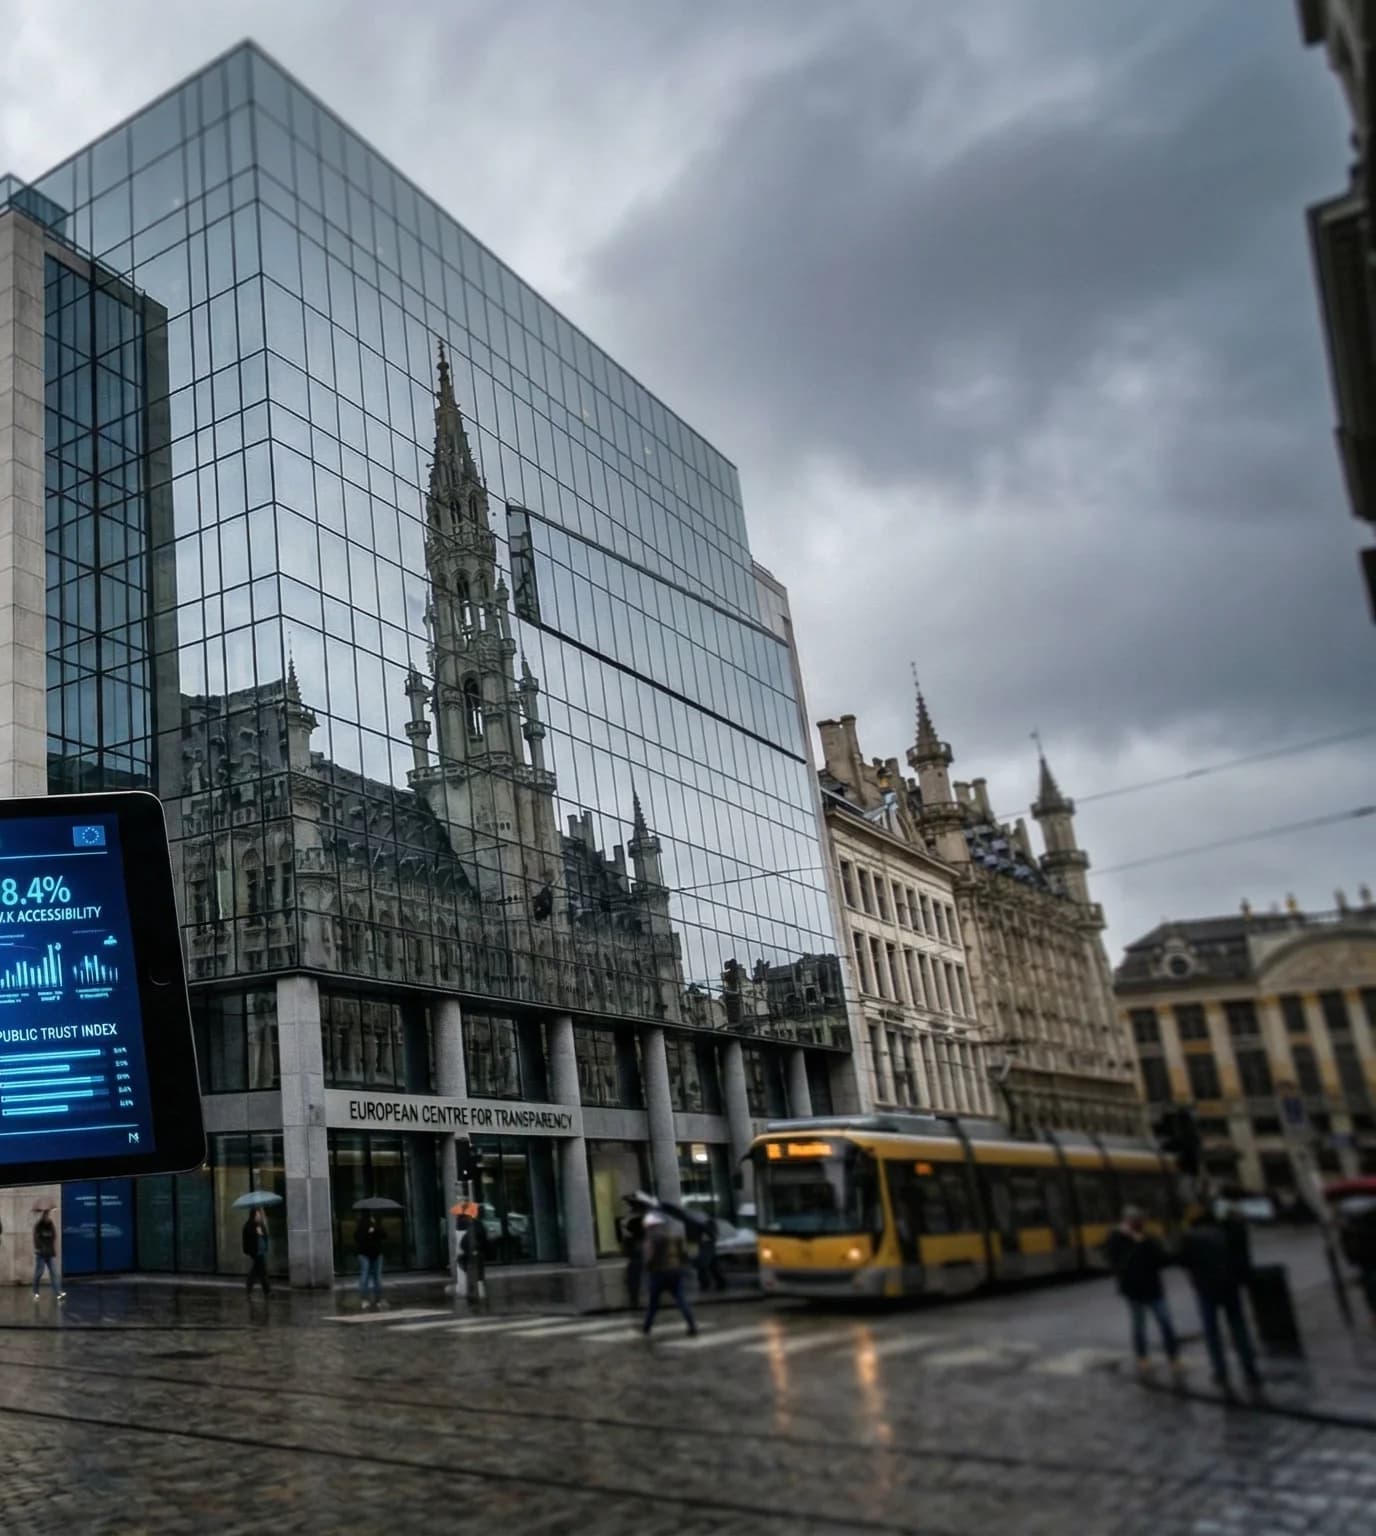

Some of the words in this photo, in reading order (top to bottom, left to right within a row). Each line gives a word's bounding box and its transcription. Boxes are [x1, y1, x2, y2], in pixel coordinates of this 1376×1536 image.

[17, 906, 102, 923] ACCESSIBILITY
[40, 1025, 78, 1040] TRUST
[81, 1023, 118, 1037] INDEX
[350, 1100, 419, 1122] EUROPEAN
[422, 1105, 469, 1125] CENTRE
[471, 1108, 493, 1127] FOR
[494, 1109, 573, 1129] TRANSPARENCY
